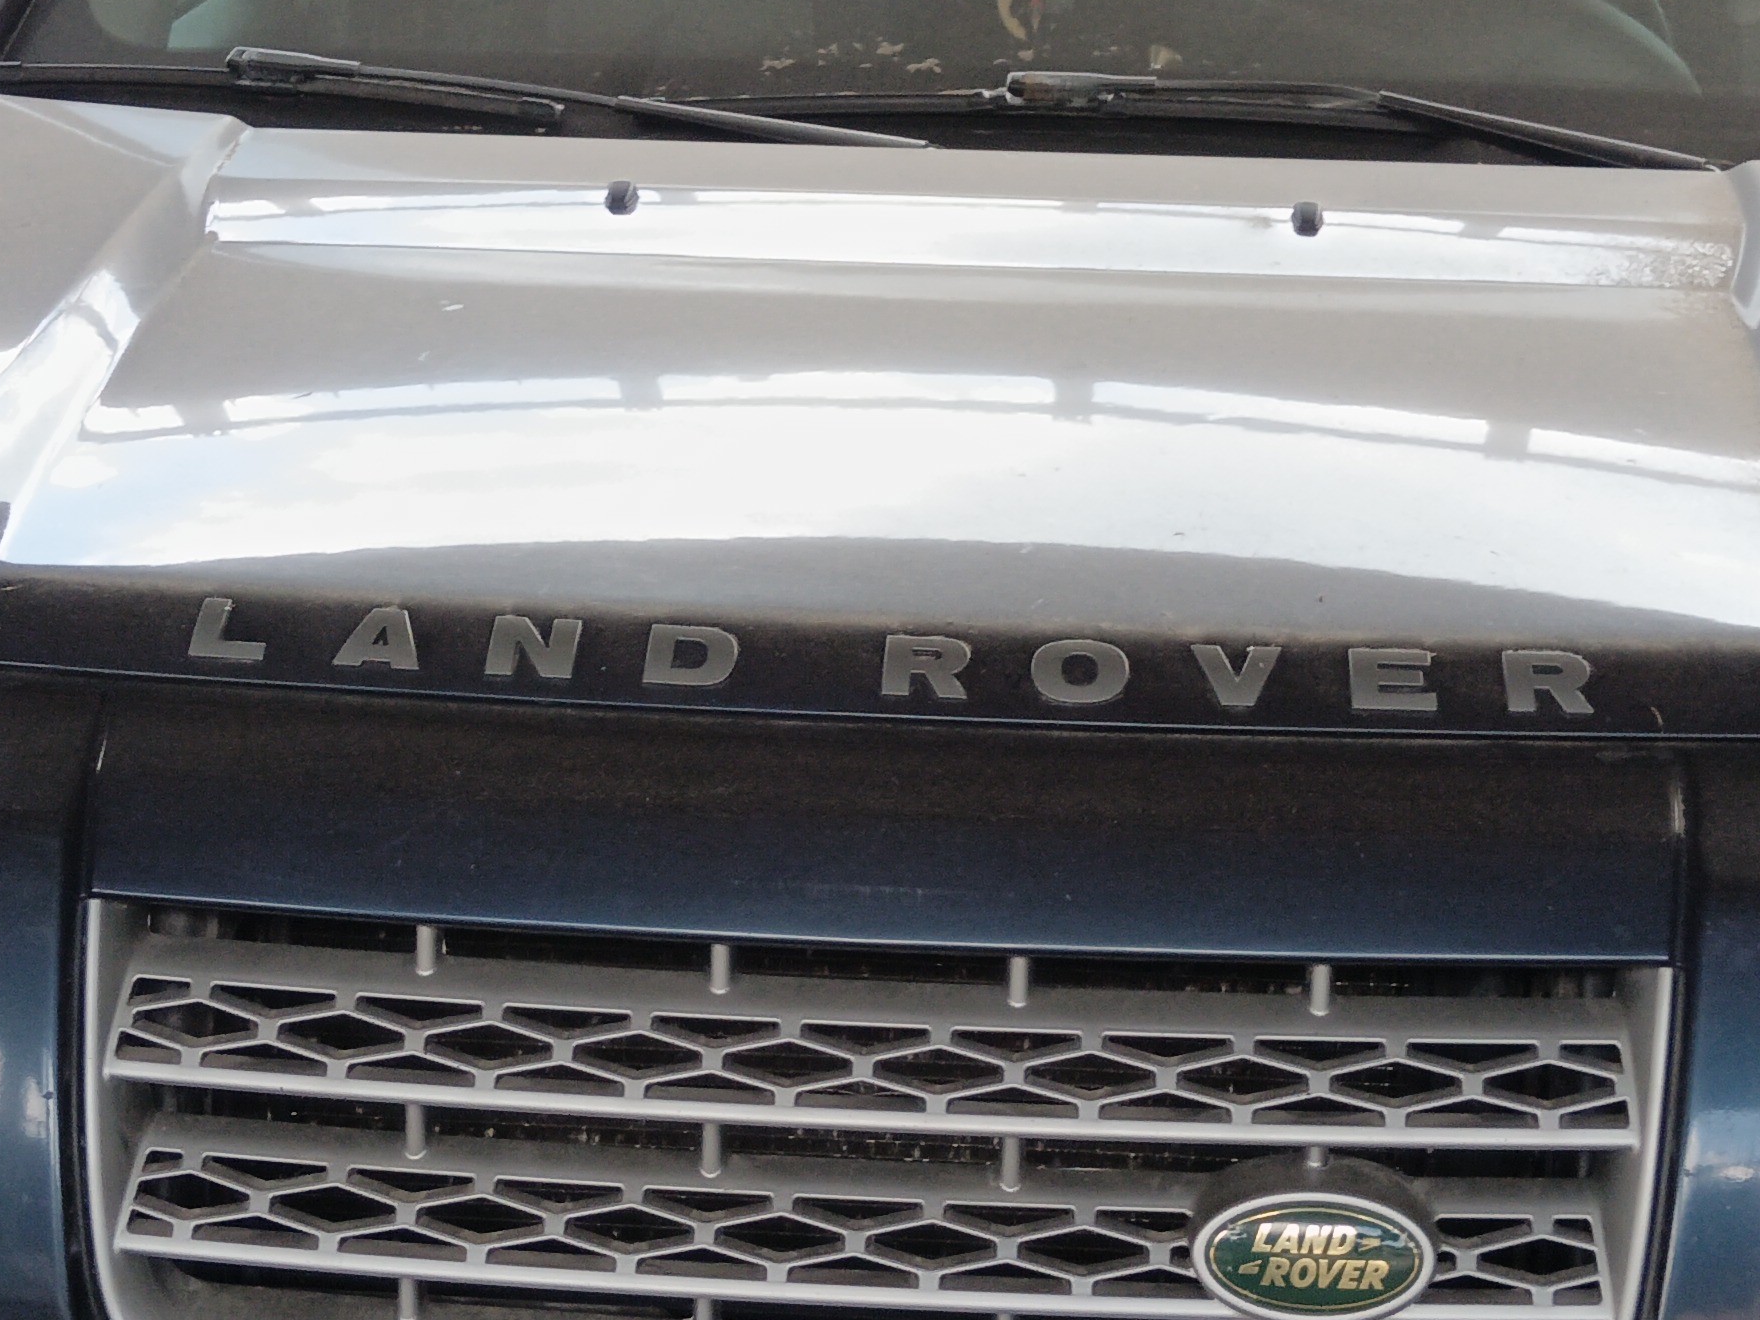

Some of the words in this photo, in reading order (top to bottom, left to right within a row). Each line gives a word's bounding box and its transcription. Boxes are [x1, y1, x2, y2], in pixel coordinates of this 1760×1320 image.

[187, 597, 740, 686] LAND
[880, 634, 1595, 714] ROVER
[1251, 1222, 1358, 1256] LAND
[1259, 1256, 1390, 1291] ROVER
